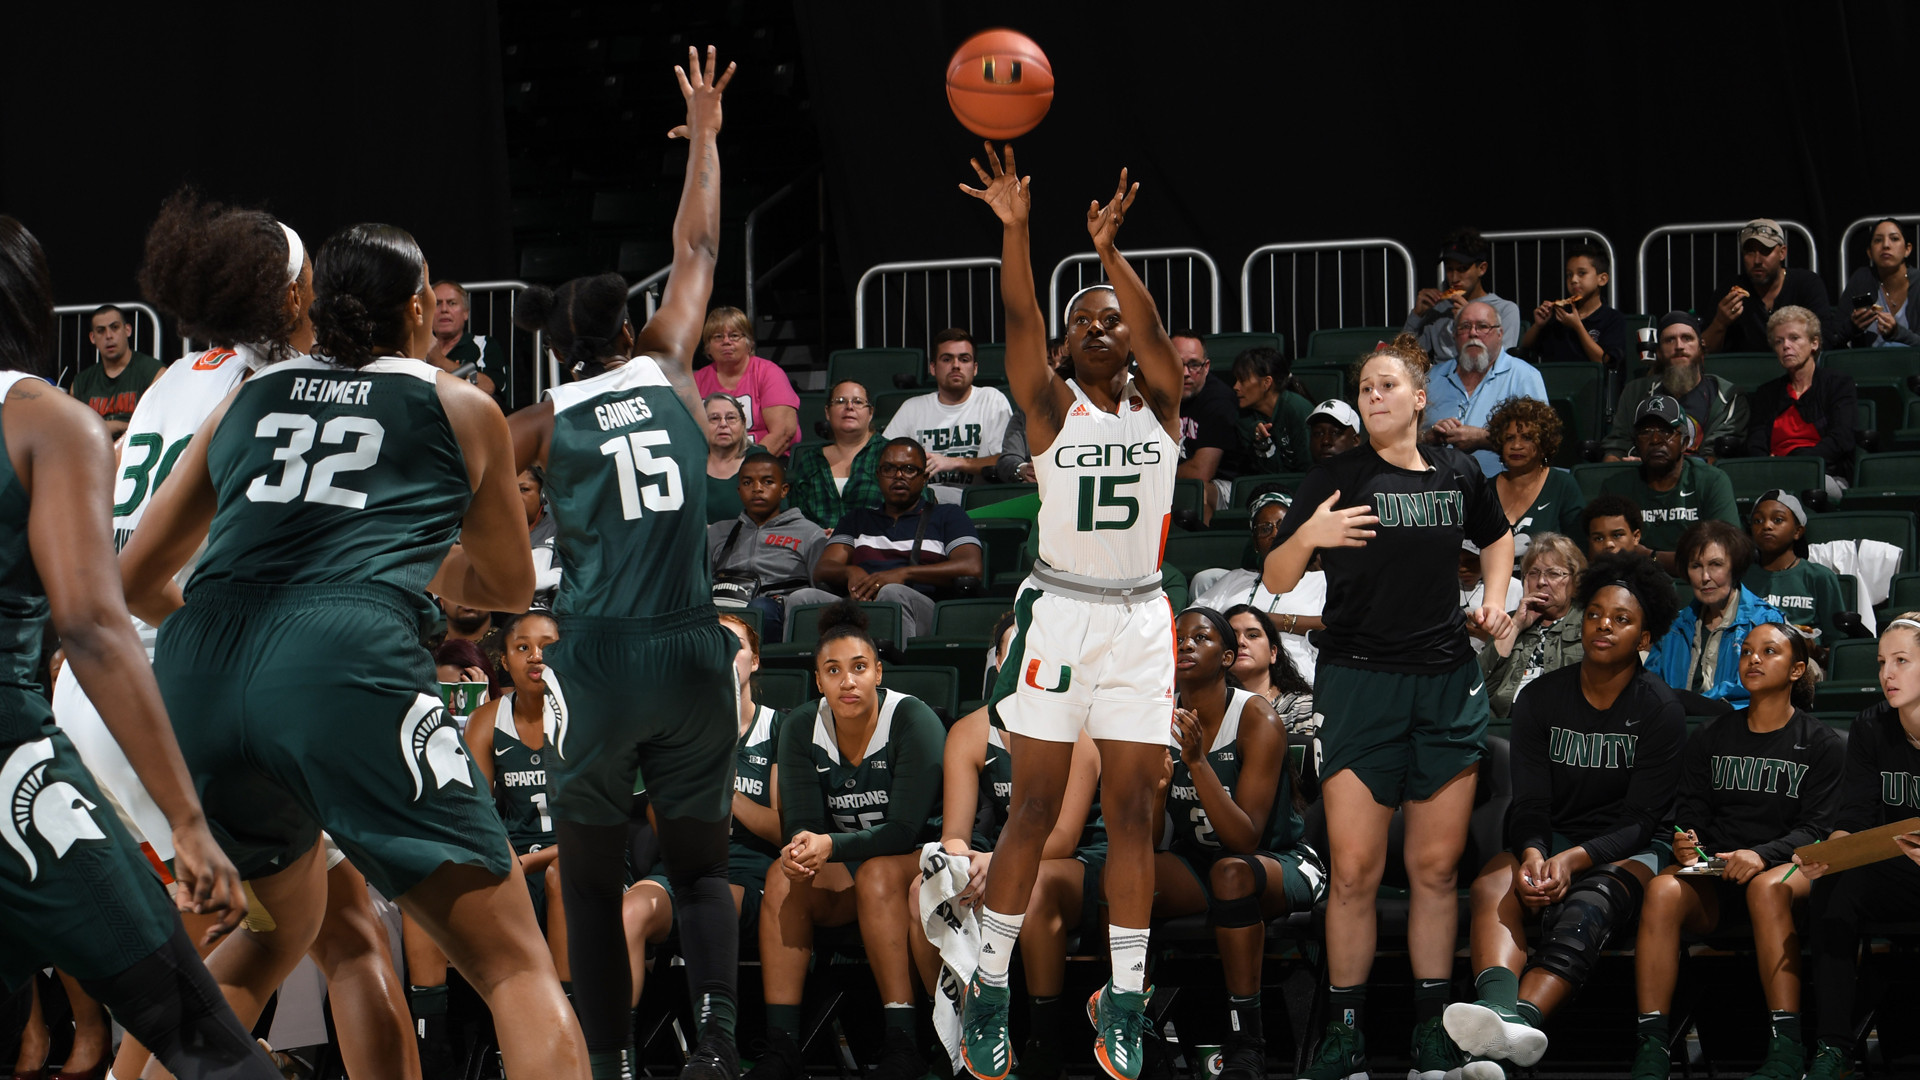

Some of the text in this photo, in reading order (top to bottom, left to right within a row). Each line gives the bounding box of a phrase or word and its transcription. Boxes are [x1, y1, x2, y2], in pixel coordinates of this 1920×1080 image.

[289, 376, 373, 406] REIMER
[594, 396, 653, 431] GAINES
[916, 423, 982, 451] FEAR
[245, 412, 386, 510] 32
[599, 429, 685, 521] 15
[1077, 473, 1141, 532] 15
[1373, 490, 1464, 527] UNITY
[1669, 507, 1699, 521] STATE
[765, 534, 802, 551] DEPT
[712, 583, 739, 592] PUMA
[1781, 596, 1814, 609] STATE
[1549, 726, 1639, 769] UNITY
[1711, 755, 1809, 799] UNITY
[530, 792, 552, 833] 1
